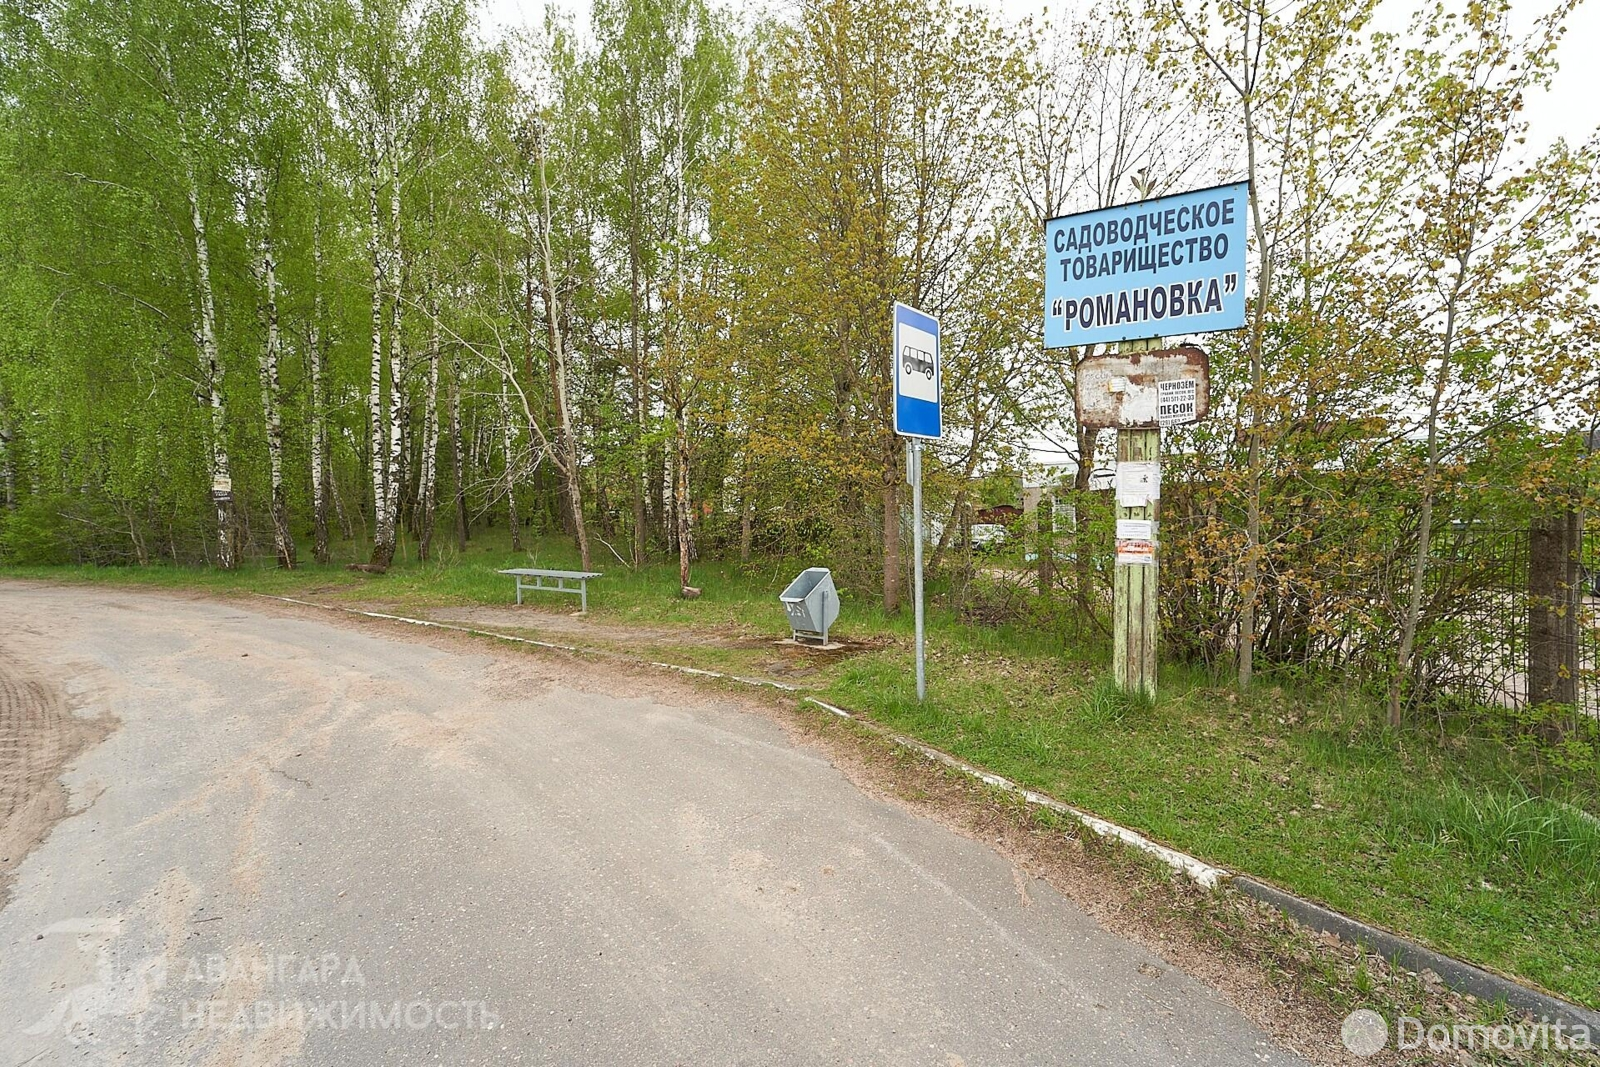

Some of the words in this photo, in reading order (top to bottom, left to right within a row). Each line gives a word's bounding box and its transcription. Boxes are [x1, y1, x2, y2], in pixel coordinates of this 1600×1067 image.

[1054, 198, 1234, 254] САДОВОДЧЕСКОЕ
[1060, 233, 1229, 282] ТОВАРИЩЕСТВО
[1160, 380, 1194, 391] ЧЕРНОЗЕМ
[1160, 402, 1193, 415] ПЕСОК
